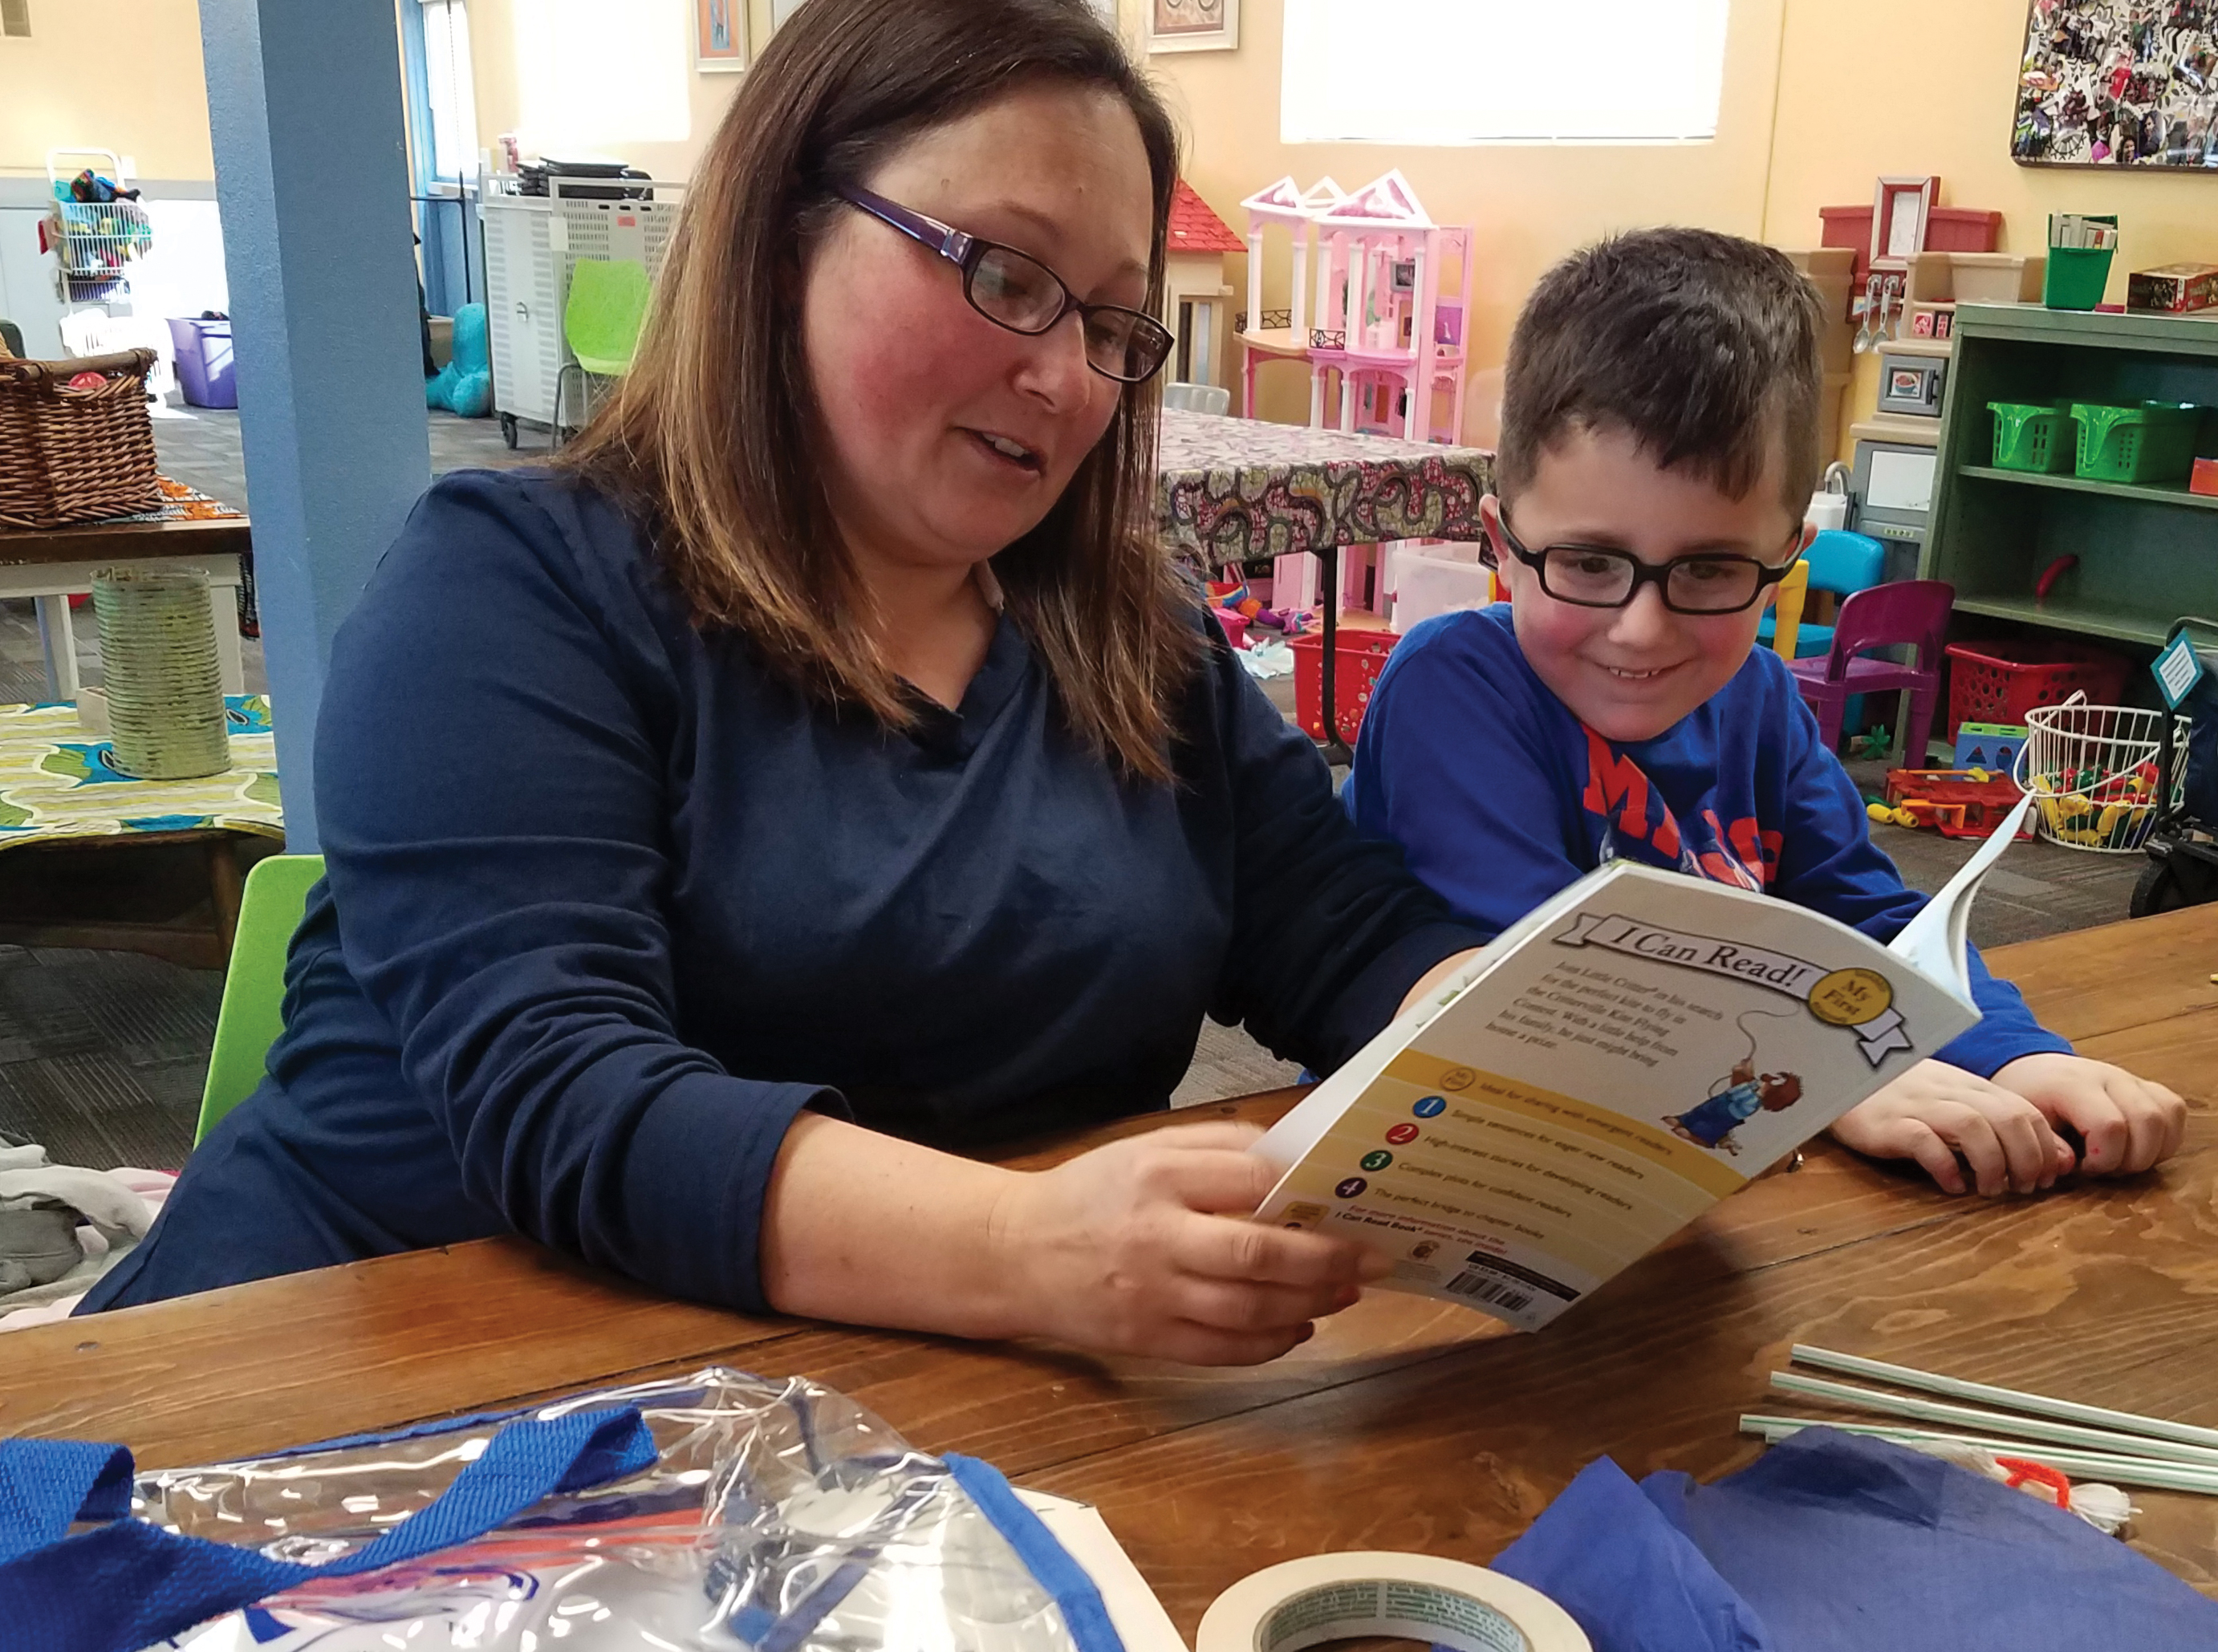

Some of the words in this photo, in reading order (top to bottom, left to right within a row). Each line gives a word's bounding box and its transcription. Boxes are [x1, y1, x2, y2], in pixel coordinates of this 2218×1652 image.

[1610, 926, 1639, 945] I
[1634, 933, 1698, 961] Can
[1703, 945, 1804, 988] Read!
[1822, 989, 1862, 1016] First
[1841, 980, 1872, 1001] My
[1607, 1160, 1644, 1179] readers
[1525, 1163, 1542, 1173] for
[1542, 1170, 1595, 1194] developing
[1595, 1190, 1633, 1211] readers
[1342, 1212, 1363, 1222] Can
[1375, 1187, 1392, 1198] The
[1514, 1224, 1545, 1240] books
[1535, 1200, 1572, 1218] readers
